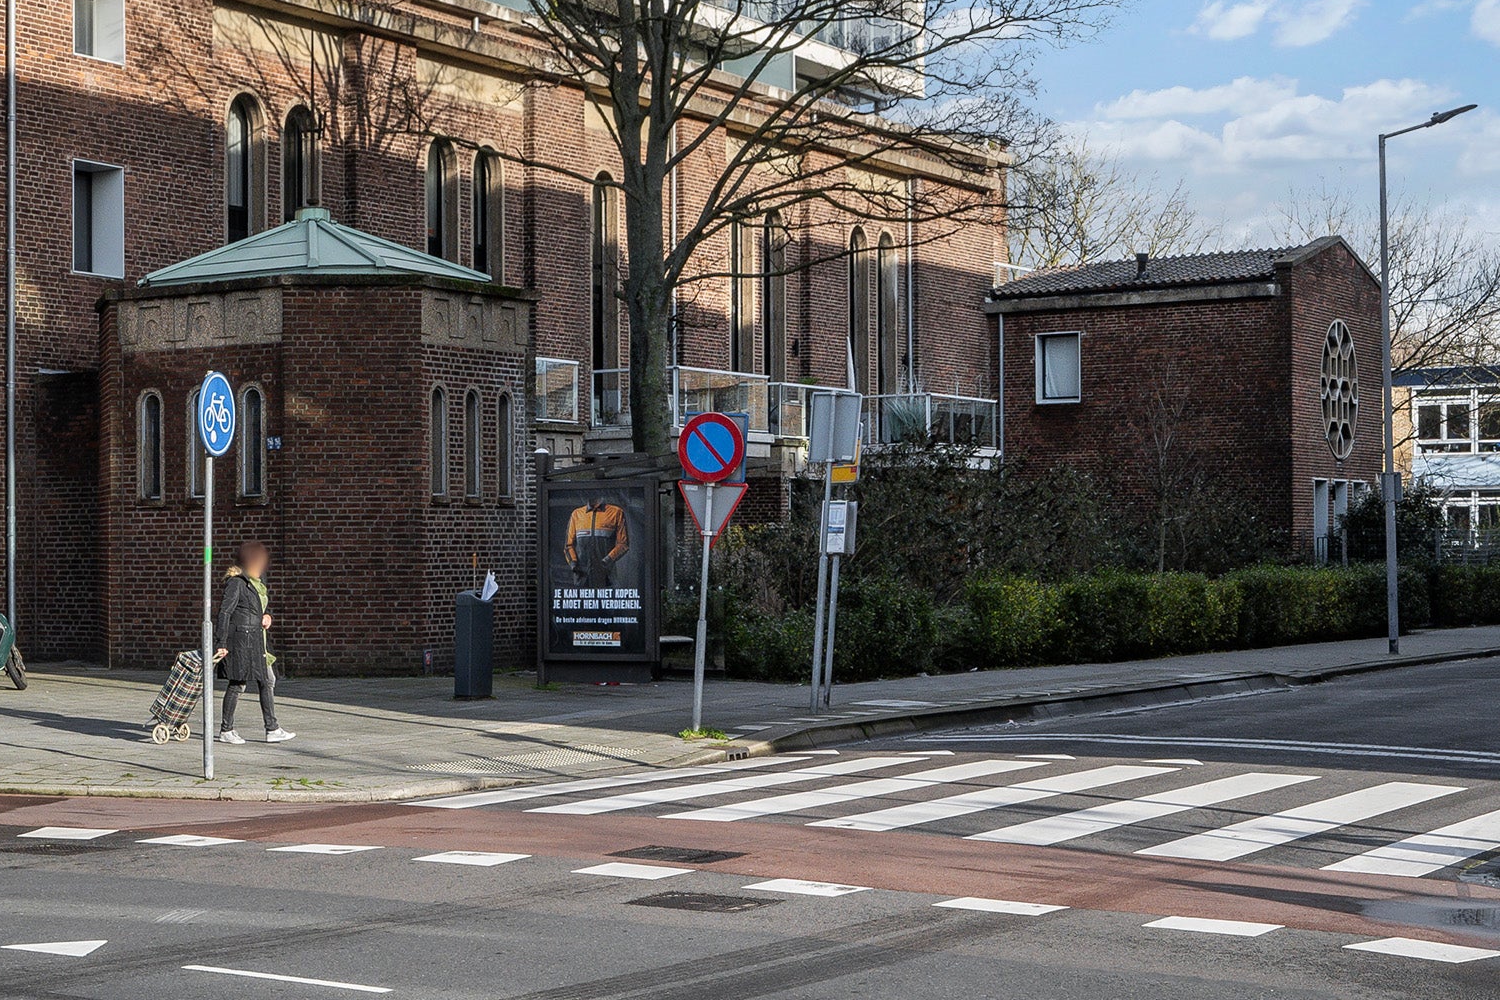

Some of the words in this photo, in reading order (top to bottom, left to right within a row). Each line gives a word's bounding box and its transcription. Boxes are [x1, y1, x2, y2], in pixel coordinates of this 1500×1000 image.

[554, 588, 562, 598] JE
[563, 588, 578, 598] KAN
[580, 588, 595, 598] HEM
[597, 588, 613, 598] NIET
[615, 588, 640, 599] KOPEN.
[553, 599, 561, 609] JE
[562, 599, 581, 609] MOET
[583, 599, 599, 609] HEM
[601, 599, 642, 610] VERDIENEN.
[573, 632, 613, 640] HORNBACH
